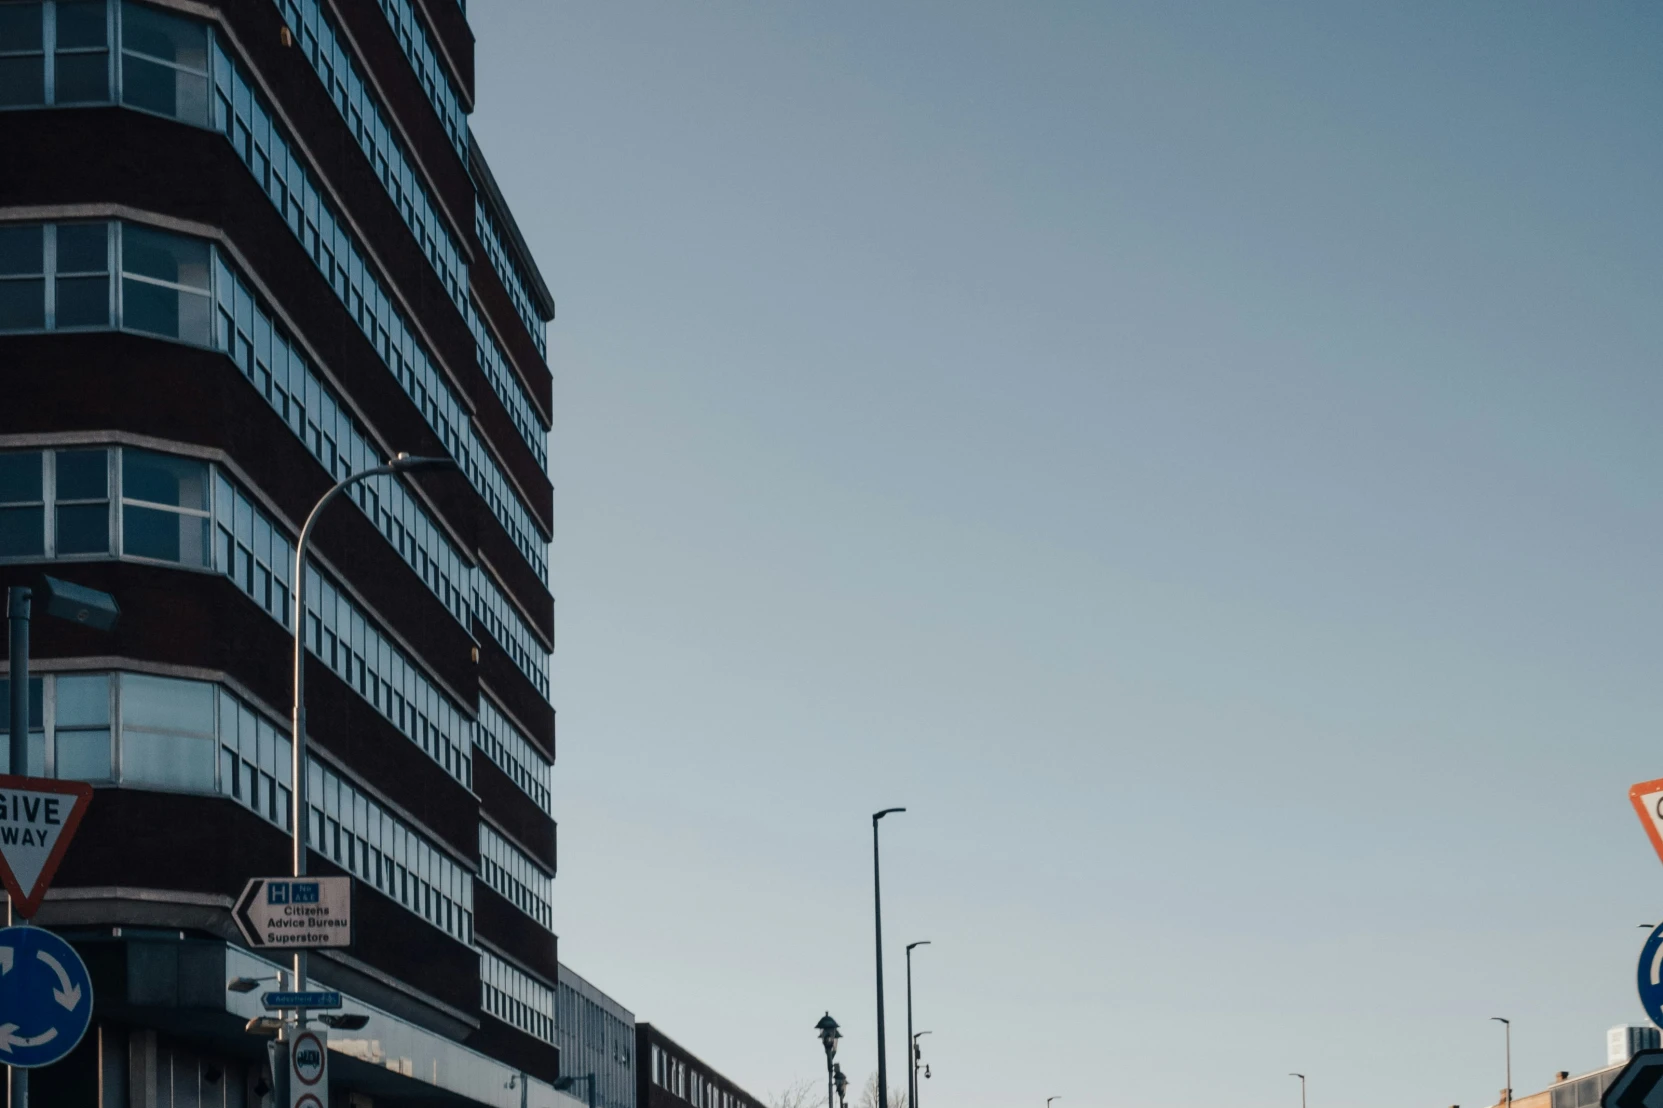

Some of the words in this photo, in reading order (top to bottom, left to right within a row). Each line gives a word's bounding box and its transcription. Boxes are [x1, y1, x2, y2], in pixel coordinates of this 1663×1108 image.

[1, 826, 48, 847] WAY
[272, 885, 285, 902] H
[284, 906, 330, 916] Citizens
[267, 918, 305, 928] Advice
[307, 918, 348, 928] Bureau
[267, 932, 329, 944] Superstore
